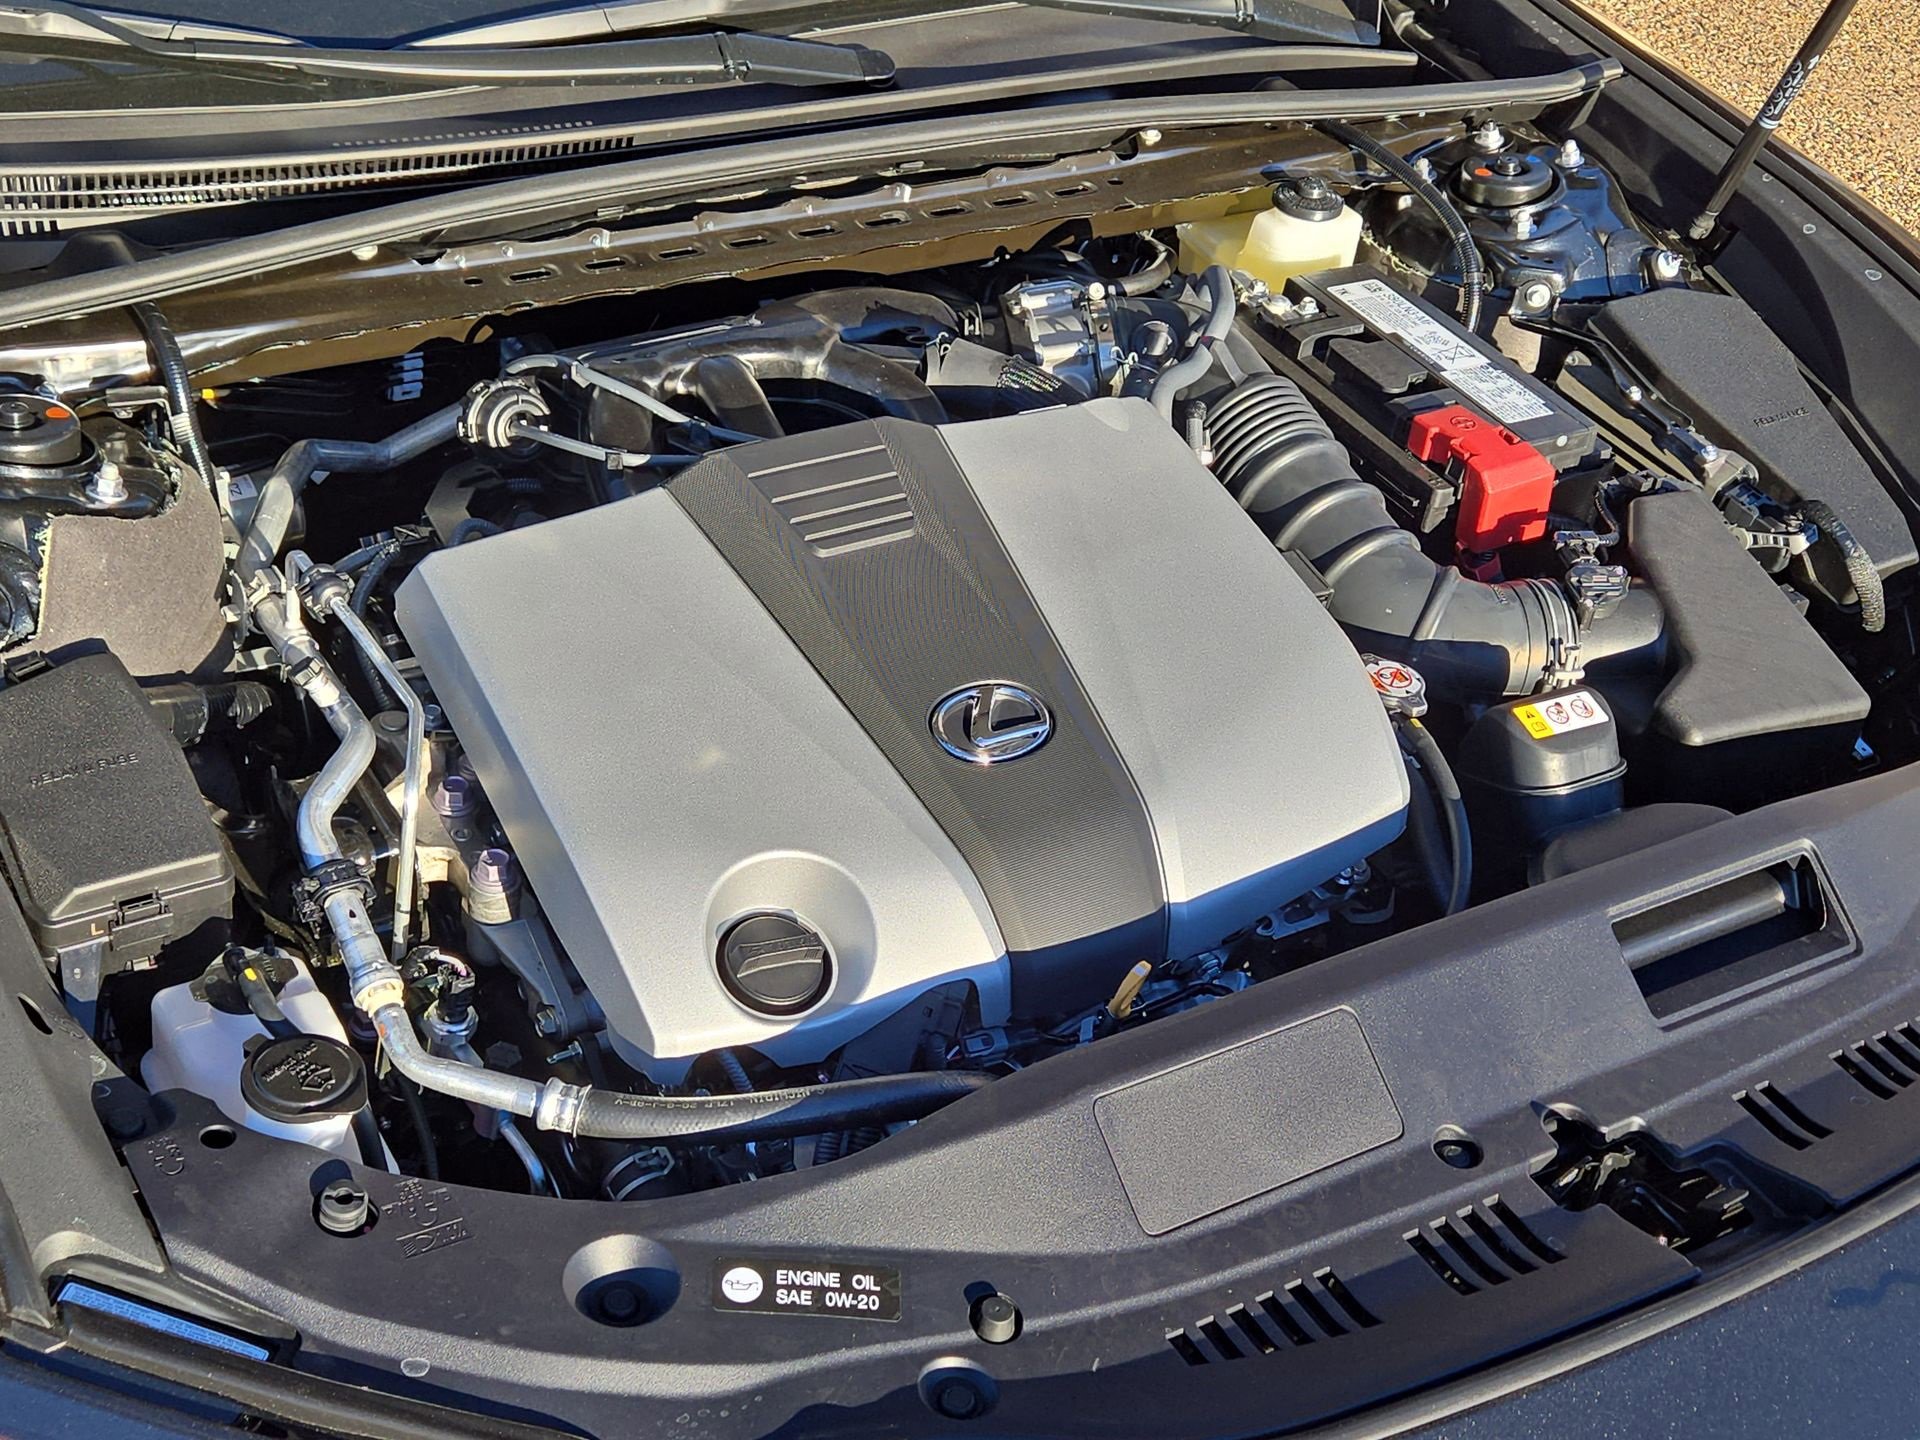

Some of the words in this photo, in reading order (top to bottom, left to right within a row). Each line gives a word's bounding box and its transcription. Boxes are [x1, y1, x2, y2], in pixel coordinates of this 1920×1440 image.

[30, 765, 79, 788] RELAY
[97, 753, 139, 771] FUSE
[90, 922, 105, 936] L
[775, 1269, 841, 1288] ENGINE
[852, 1274, 881, 1292] OIL
[775, 1289, 813, 1306] SAE
[825, 1292, 880, 1310] 0W-20
